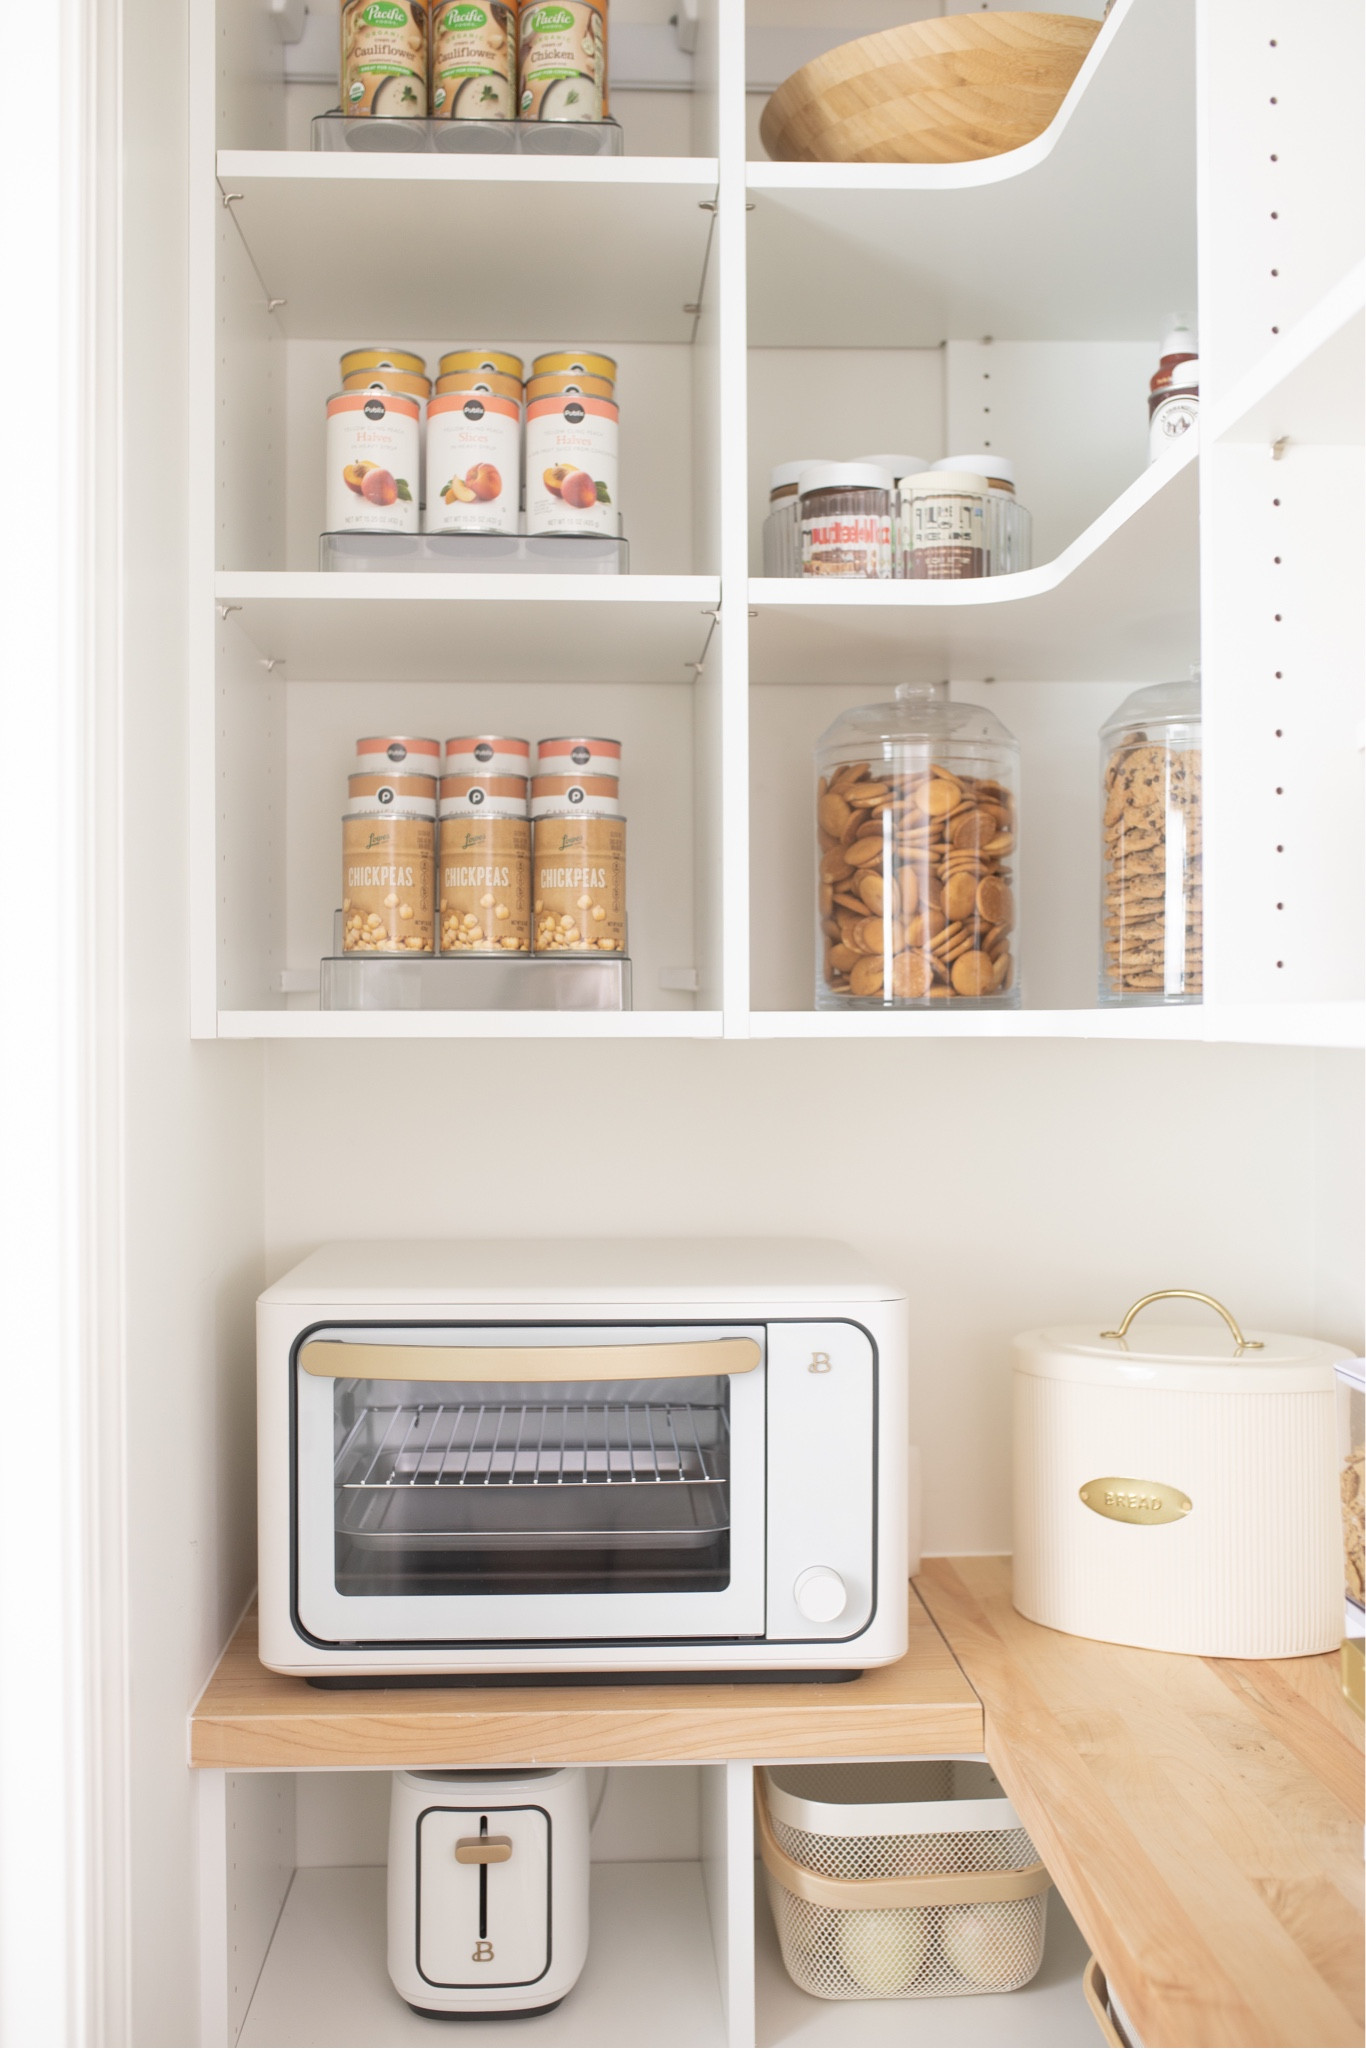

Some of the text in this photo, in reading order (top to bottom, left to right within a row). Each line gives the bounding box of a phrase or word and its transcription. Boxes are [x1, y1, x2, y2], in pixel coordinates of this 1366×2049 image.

[366, 5, 405, 22] Pacific
[447, 9, 484, 26] Pacific
[535, 11, 571, 28] Pacific
[354, 44, 416, 61] Cauliflower
[438, 47, 496, 64] Cauliflower
[531, 49, 575, 63] Chicken
[364, 406, 386, 414] Publix
[464, 406, 485, 414] Publix
[564, 409, 585, 417] Publix
[356, 431, 393, 443] Halves
[458, 432, 489, 443] Slices
[556, 434, 593, 446] Halves
[348, 866, 414, 888] CHICKPEAS
[445, 866, 510, 888] CHICKPEAS
[540, 867, 605, 889] CHICKPEAS
[808, 1352, 832, 1374] B
[1104, 1492, 1162, 1511] BREAD
[472, 1941, 494, 1962] B
